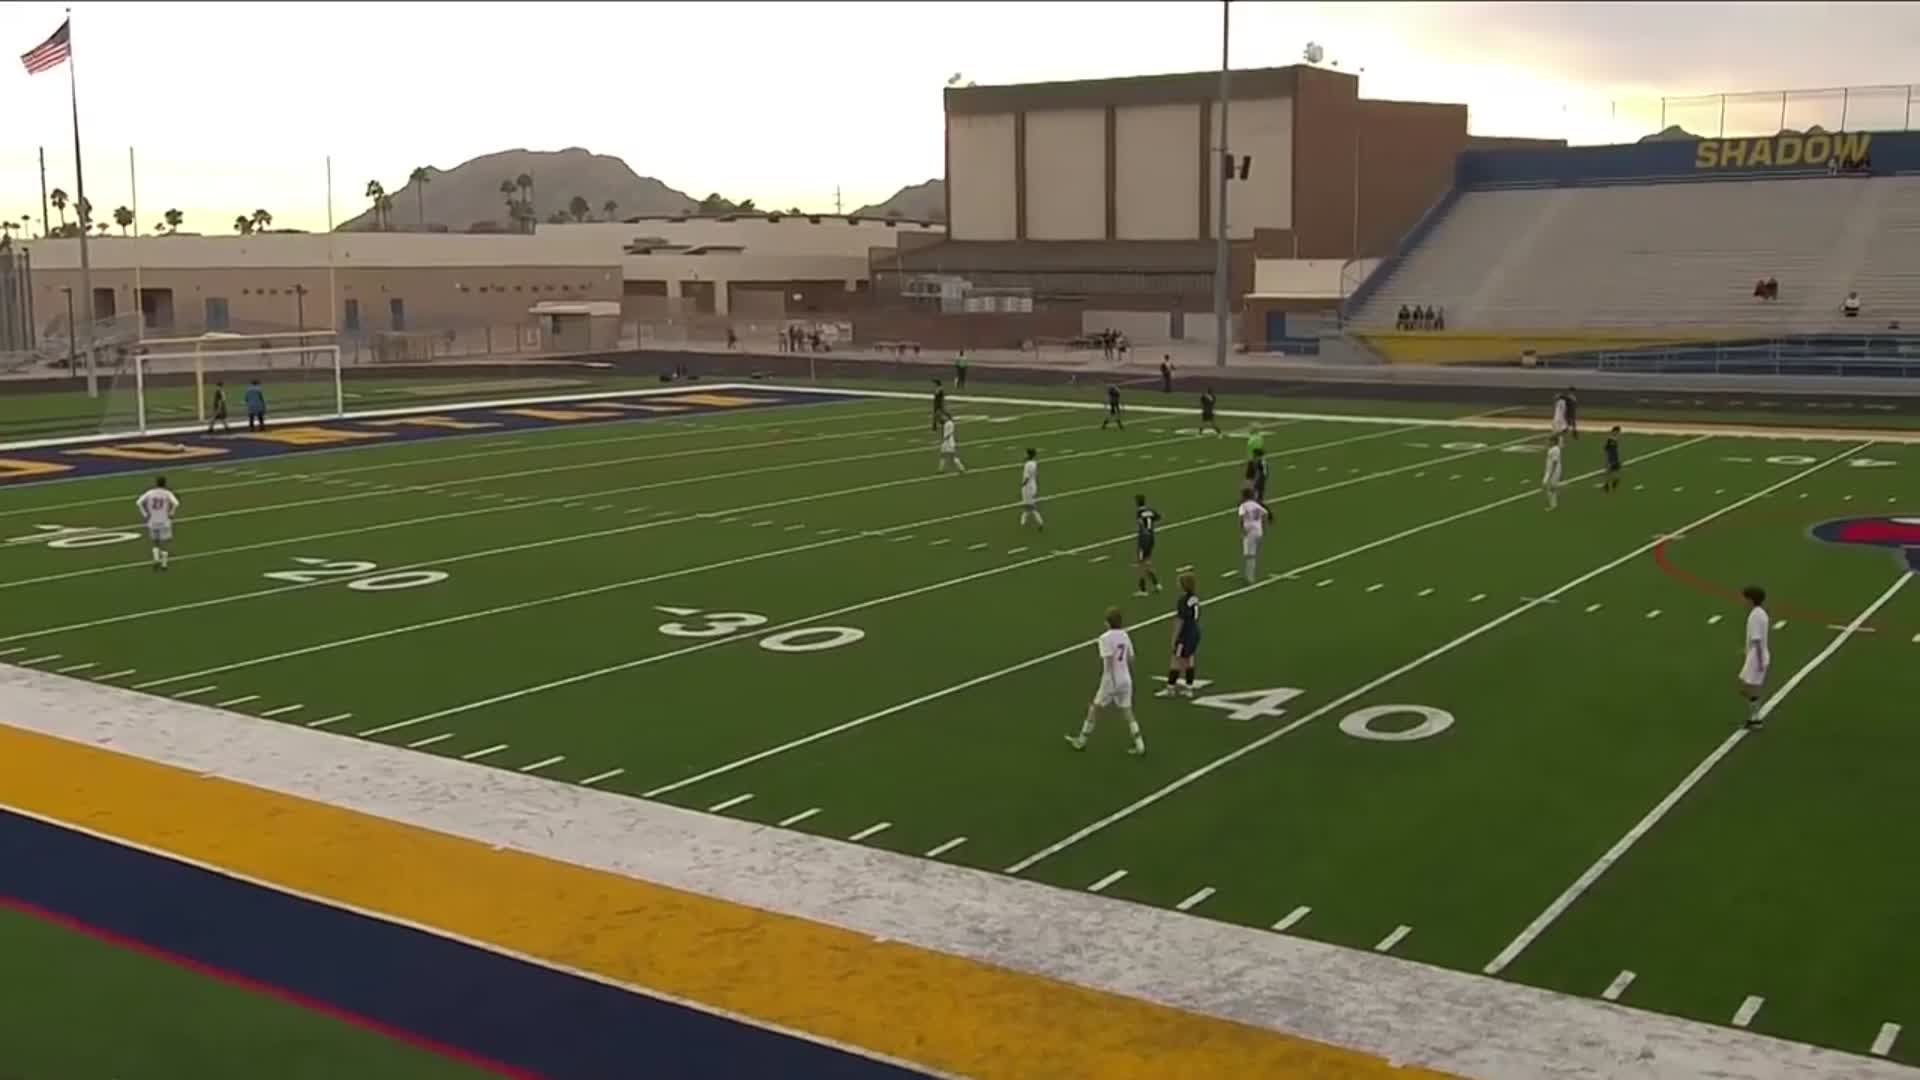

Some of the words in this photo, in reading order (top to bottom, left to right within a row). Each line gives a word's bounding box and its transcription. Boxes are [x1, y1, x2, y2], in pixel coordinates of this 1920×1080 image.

[1695, 134, 1872, 168] SHADOW
[263, 561, 450, 590] 20
[658, 612, 865, 651] 30
[1117, 644, 1125, 662] 7
[1190, 687, 1456, 741] 40
